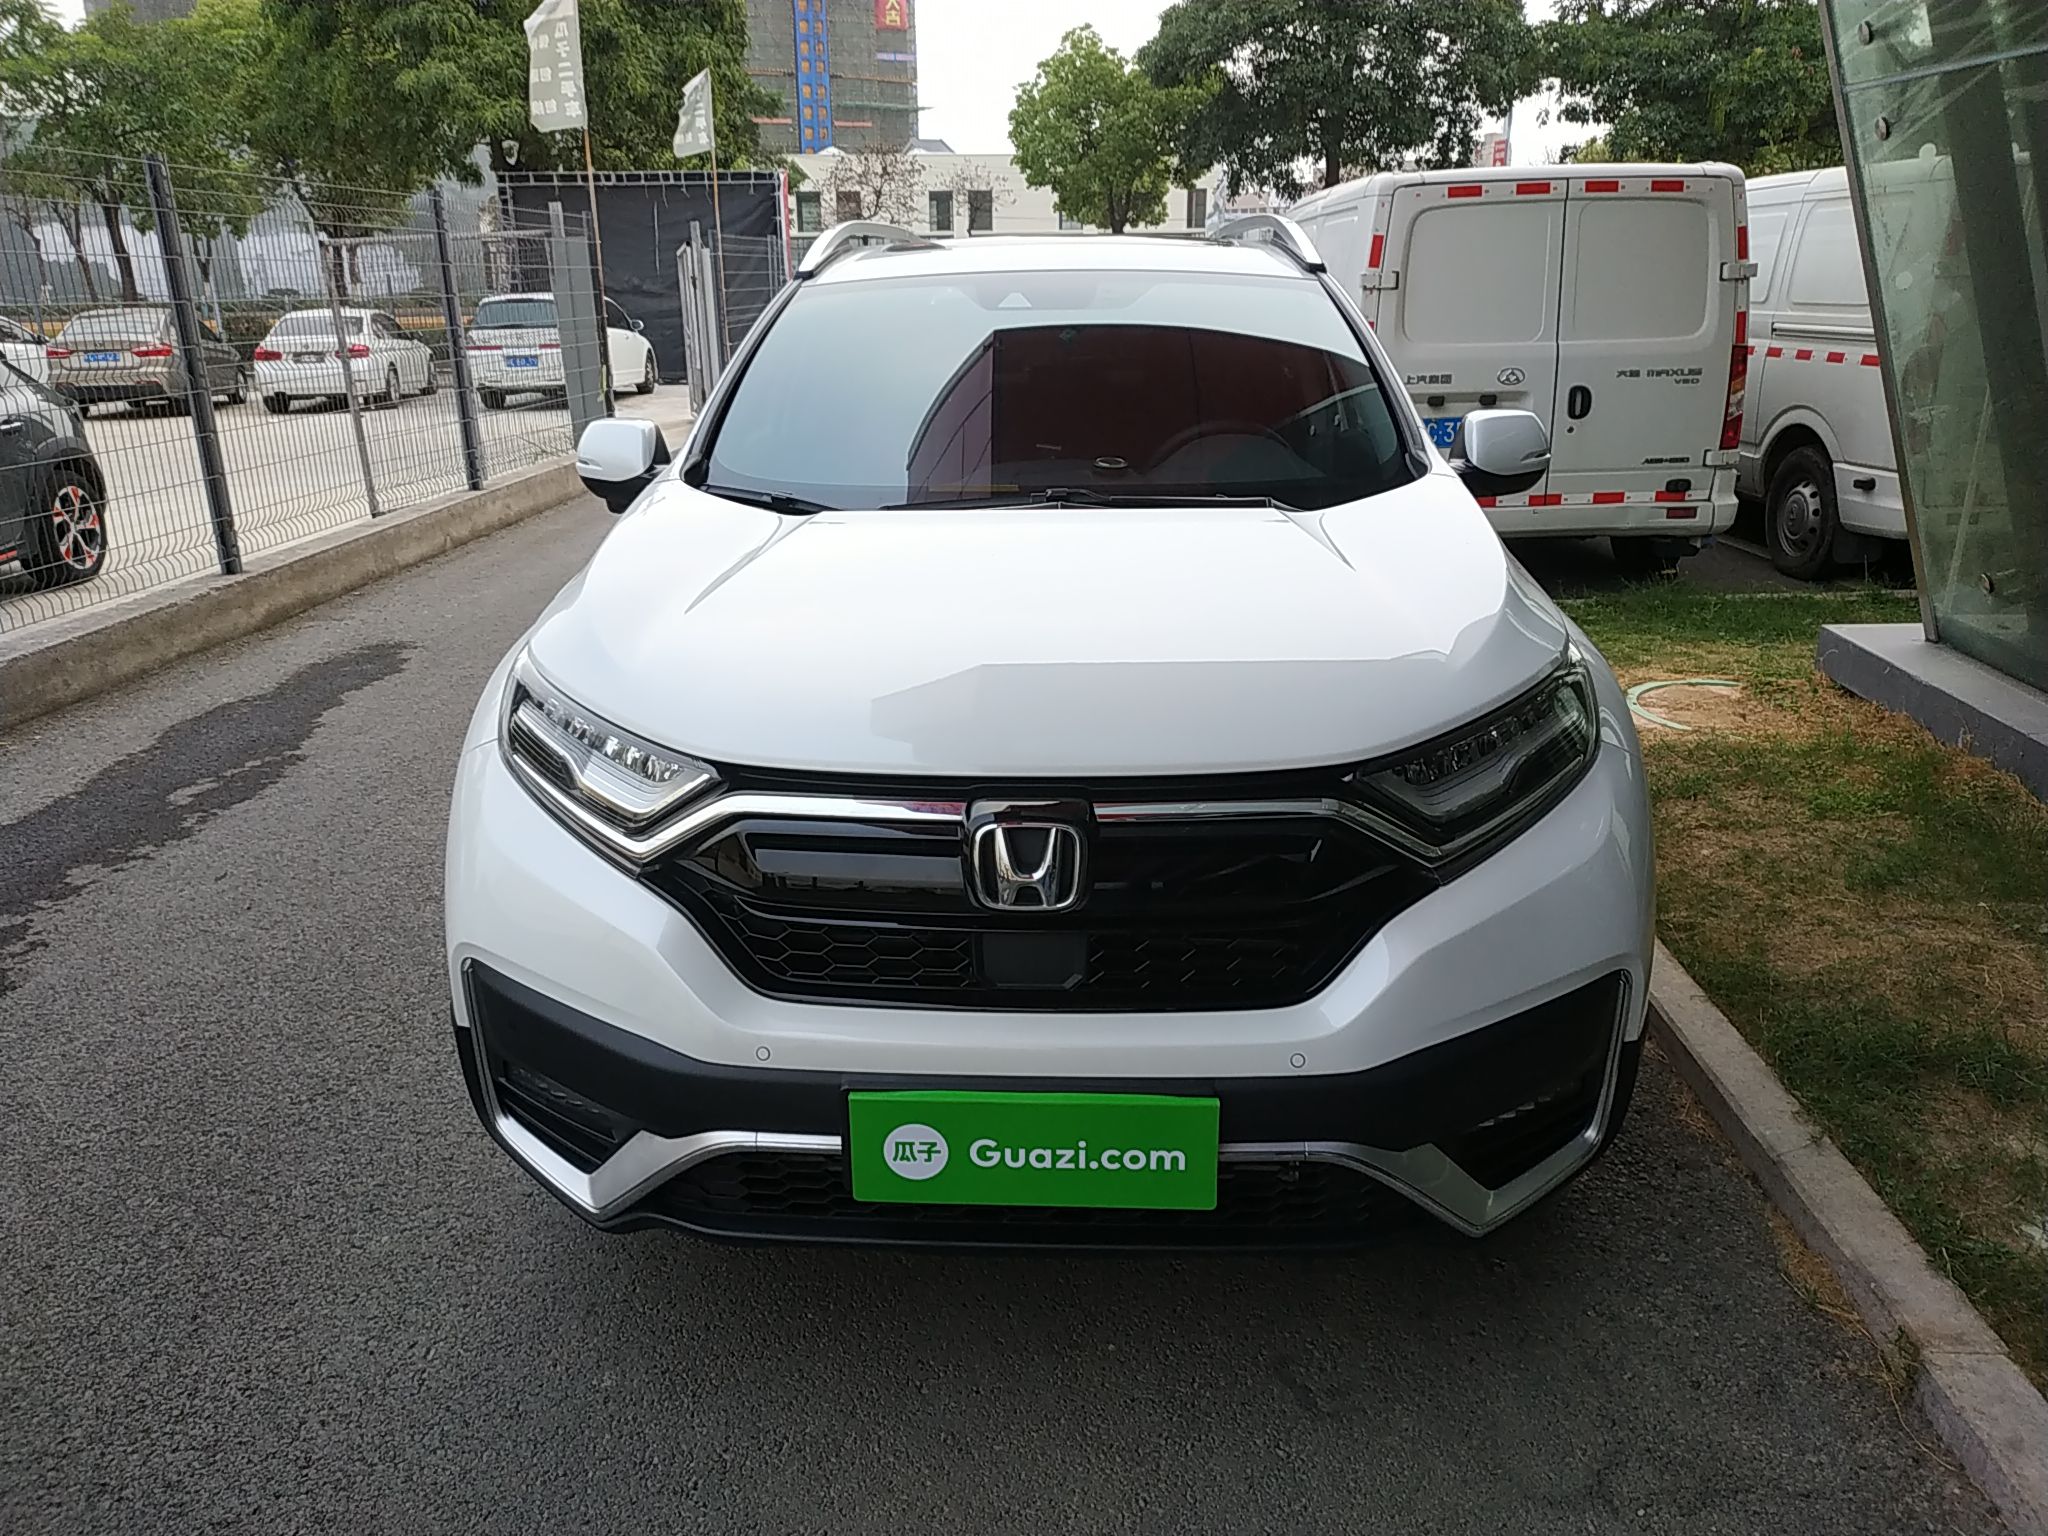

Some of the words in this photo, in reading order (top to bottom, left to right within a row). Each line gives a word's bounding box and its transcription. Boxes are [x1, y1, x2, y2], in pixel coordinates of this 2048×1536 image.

[1646, 367, 1703, 378] MAXUS
[892, 1140, 942, 1163] 瓜子
[969, 1139, 1186, 1171] Guazi.com
